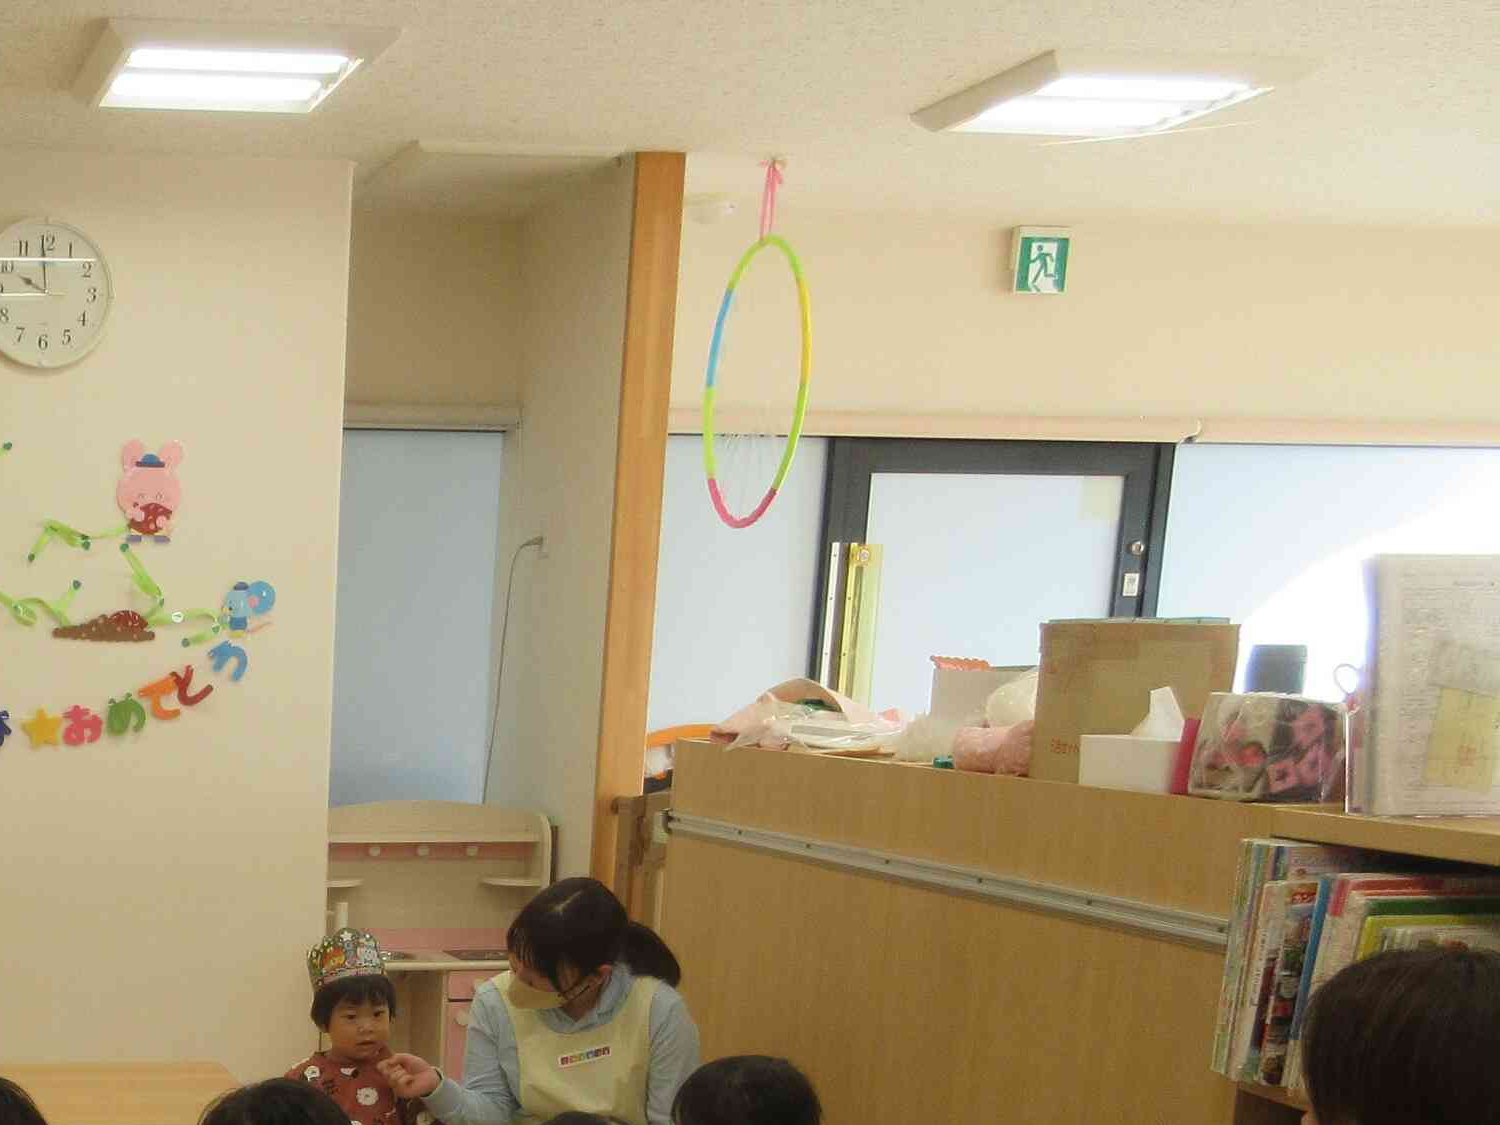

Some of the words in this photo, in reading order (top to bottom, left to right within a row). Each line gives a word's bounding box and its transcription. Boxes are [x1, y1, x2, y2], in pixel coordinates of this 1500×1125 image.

[18, 240, 28, 257] 11
[40, 233, 55, 251] 12
[0, 260, 14, 274] 10
[82, 262, 92, 278] 2
[86, 288, 97, 303] 3
[0, 307, 9, 323] 8
[77, 310, 89, 326] 4
[15, 326, 25, 342] 7
[38, 334, 48, 350] 6
[62, 329, 71, 345] 5
